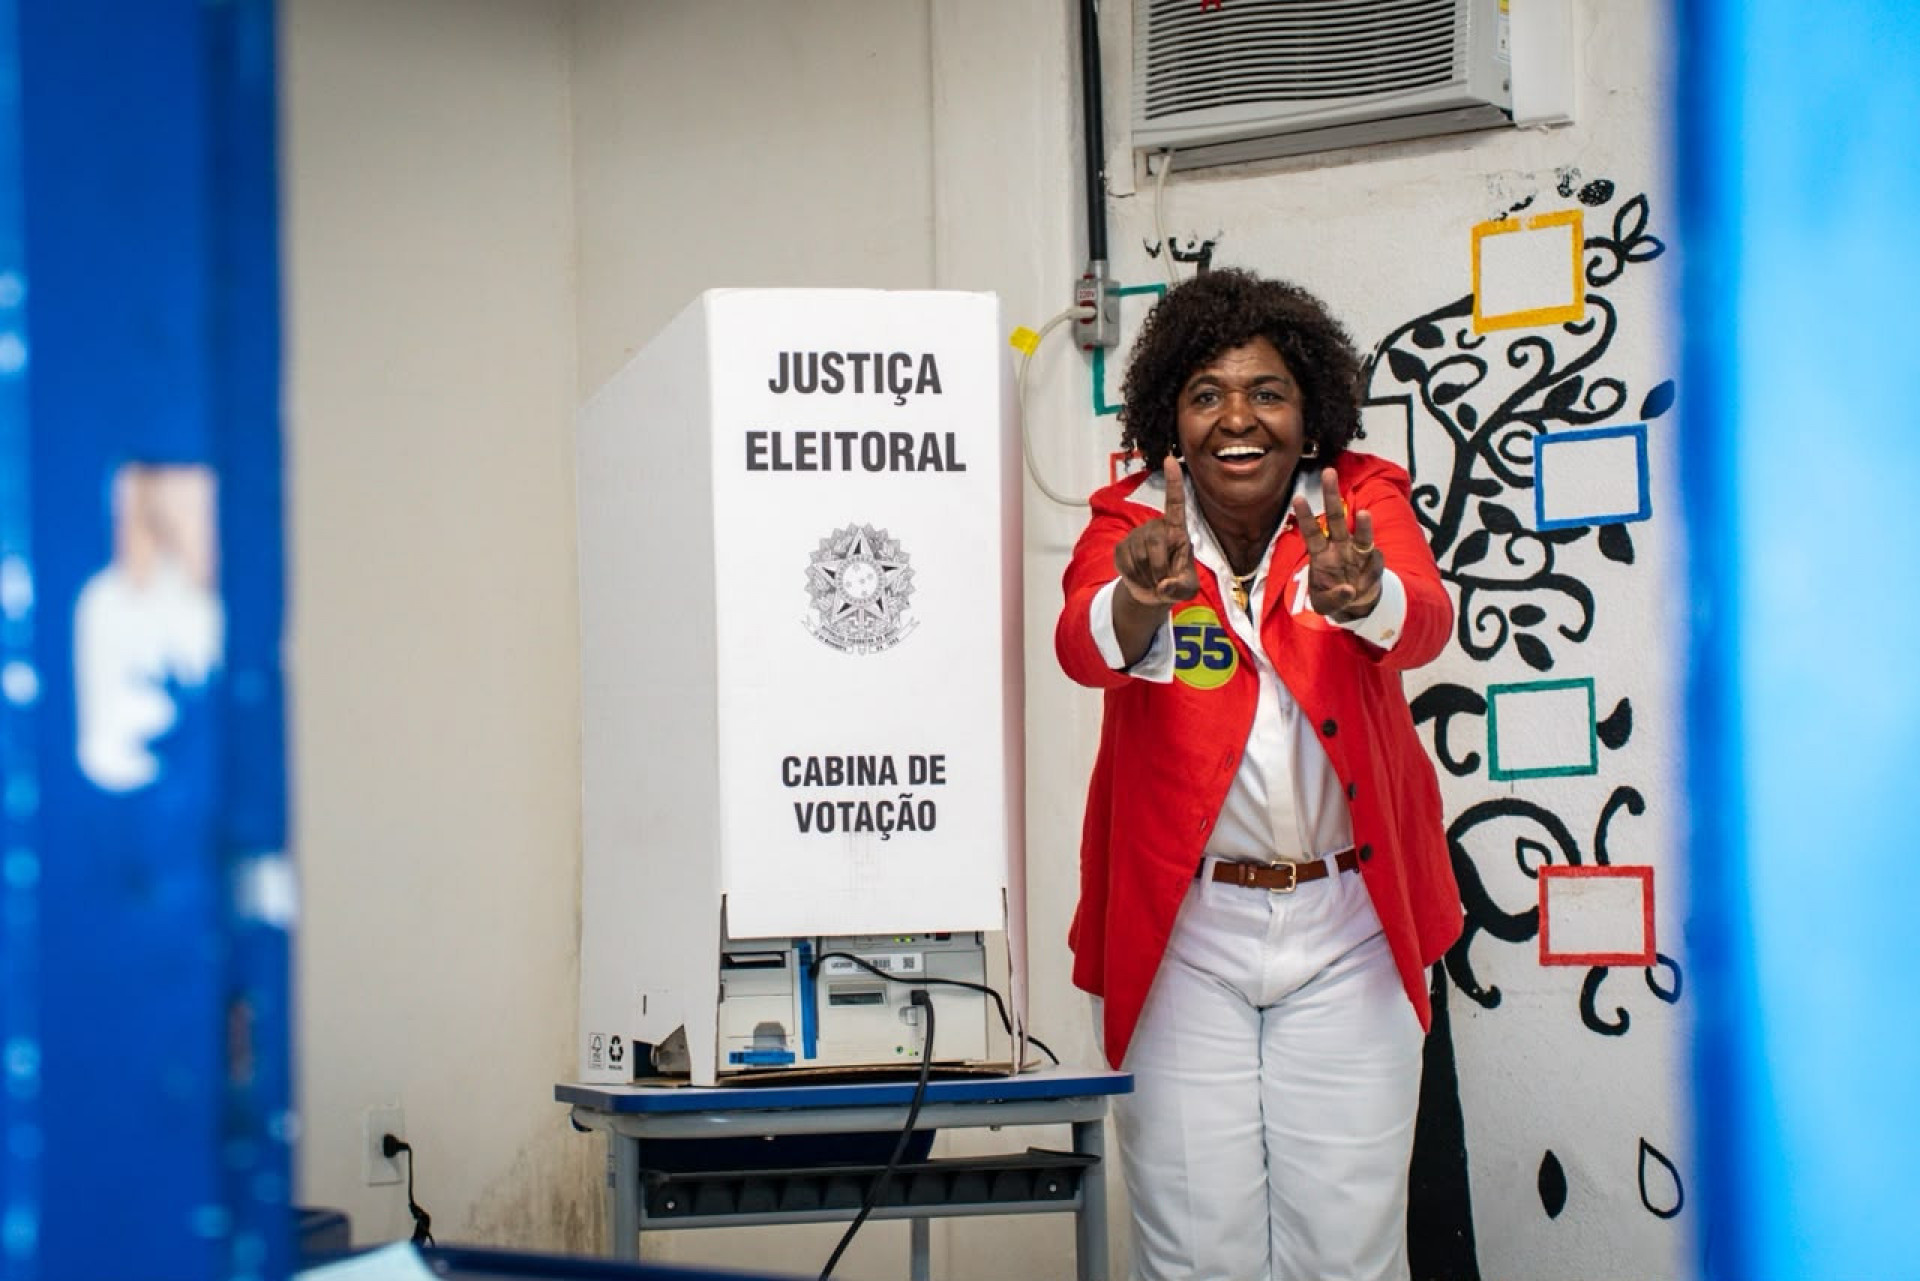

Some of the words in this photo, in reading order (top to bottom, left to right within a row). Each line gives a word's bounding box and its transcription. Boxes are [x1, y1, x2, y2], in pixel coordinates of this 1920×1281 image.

[768, 351, 942, 406] JUSTIÇA
[746, 431, 967, 472] ELEITORAL
[1173, 626, 1234, 670] 55
[782, 755, 898, 787] CABINA
[908, 754, 946, 786] DE
[794, 792, 937, 841] VOTAÇÃO
